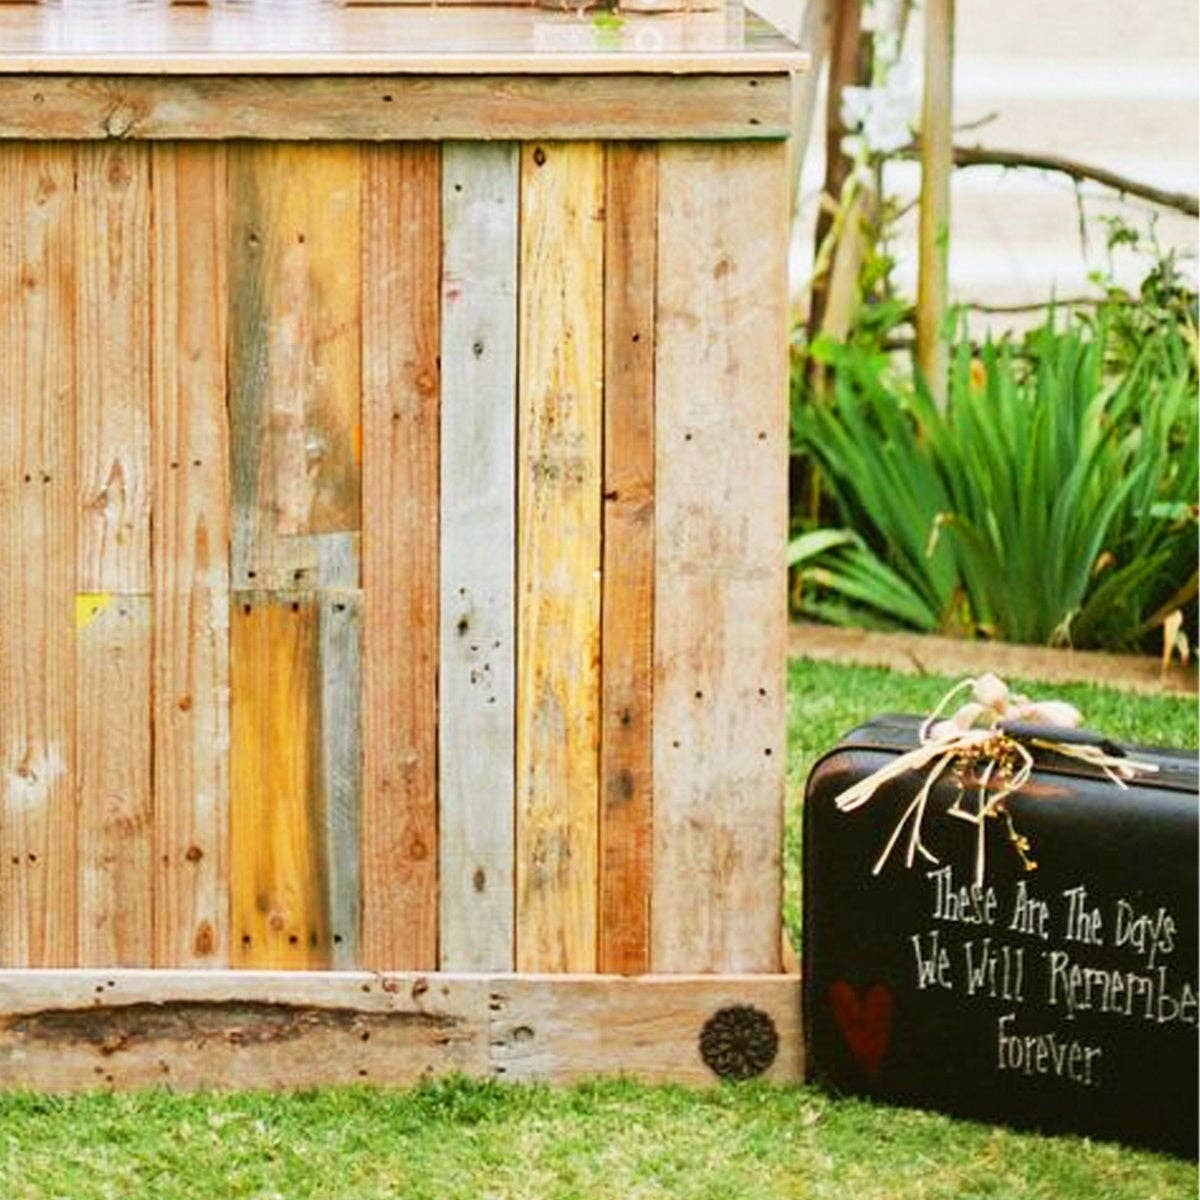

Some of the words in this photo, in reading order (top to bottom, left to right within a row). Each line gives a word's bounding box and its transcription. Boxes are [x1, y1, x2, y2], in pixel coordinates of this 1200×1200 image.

[927, 865, 997, 925] These
[1008, 880, 1050, 940] Are
[1064, 886, 1103, 945] The
[1115, 899, 1178, 969] Days
[911, 930, 952, 989] We
[963, 937, 1025, 1002] Will
[1042, 950, 1199, 1028] Remembe
[998, 1012, 1102, 1085] Forever
